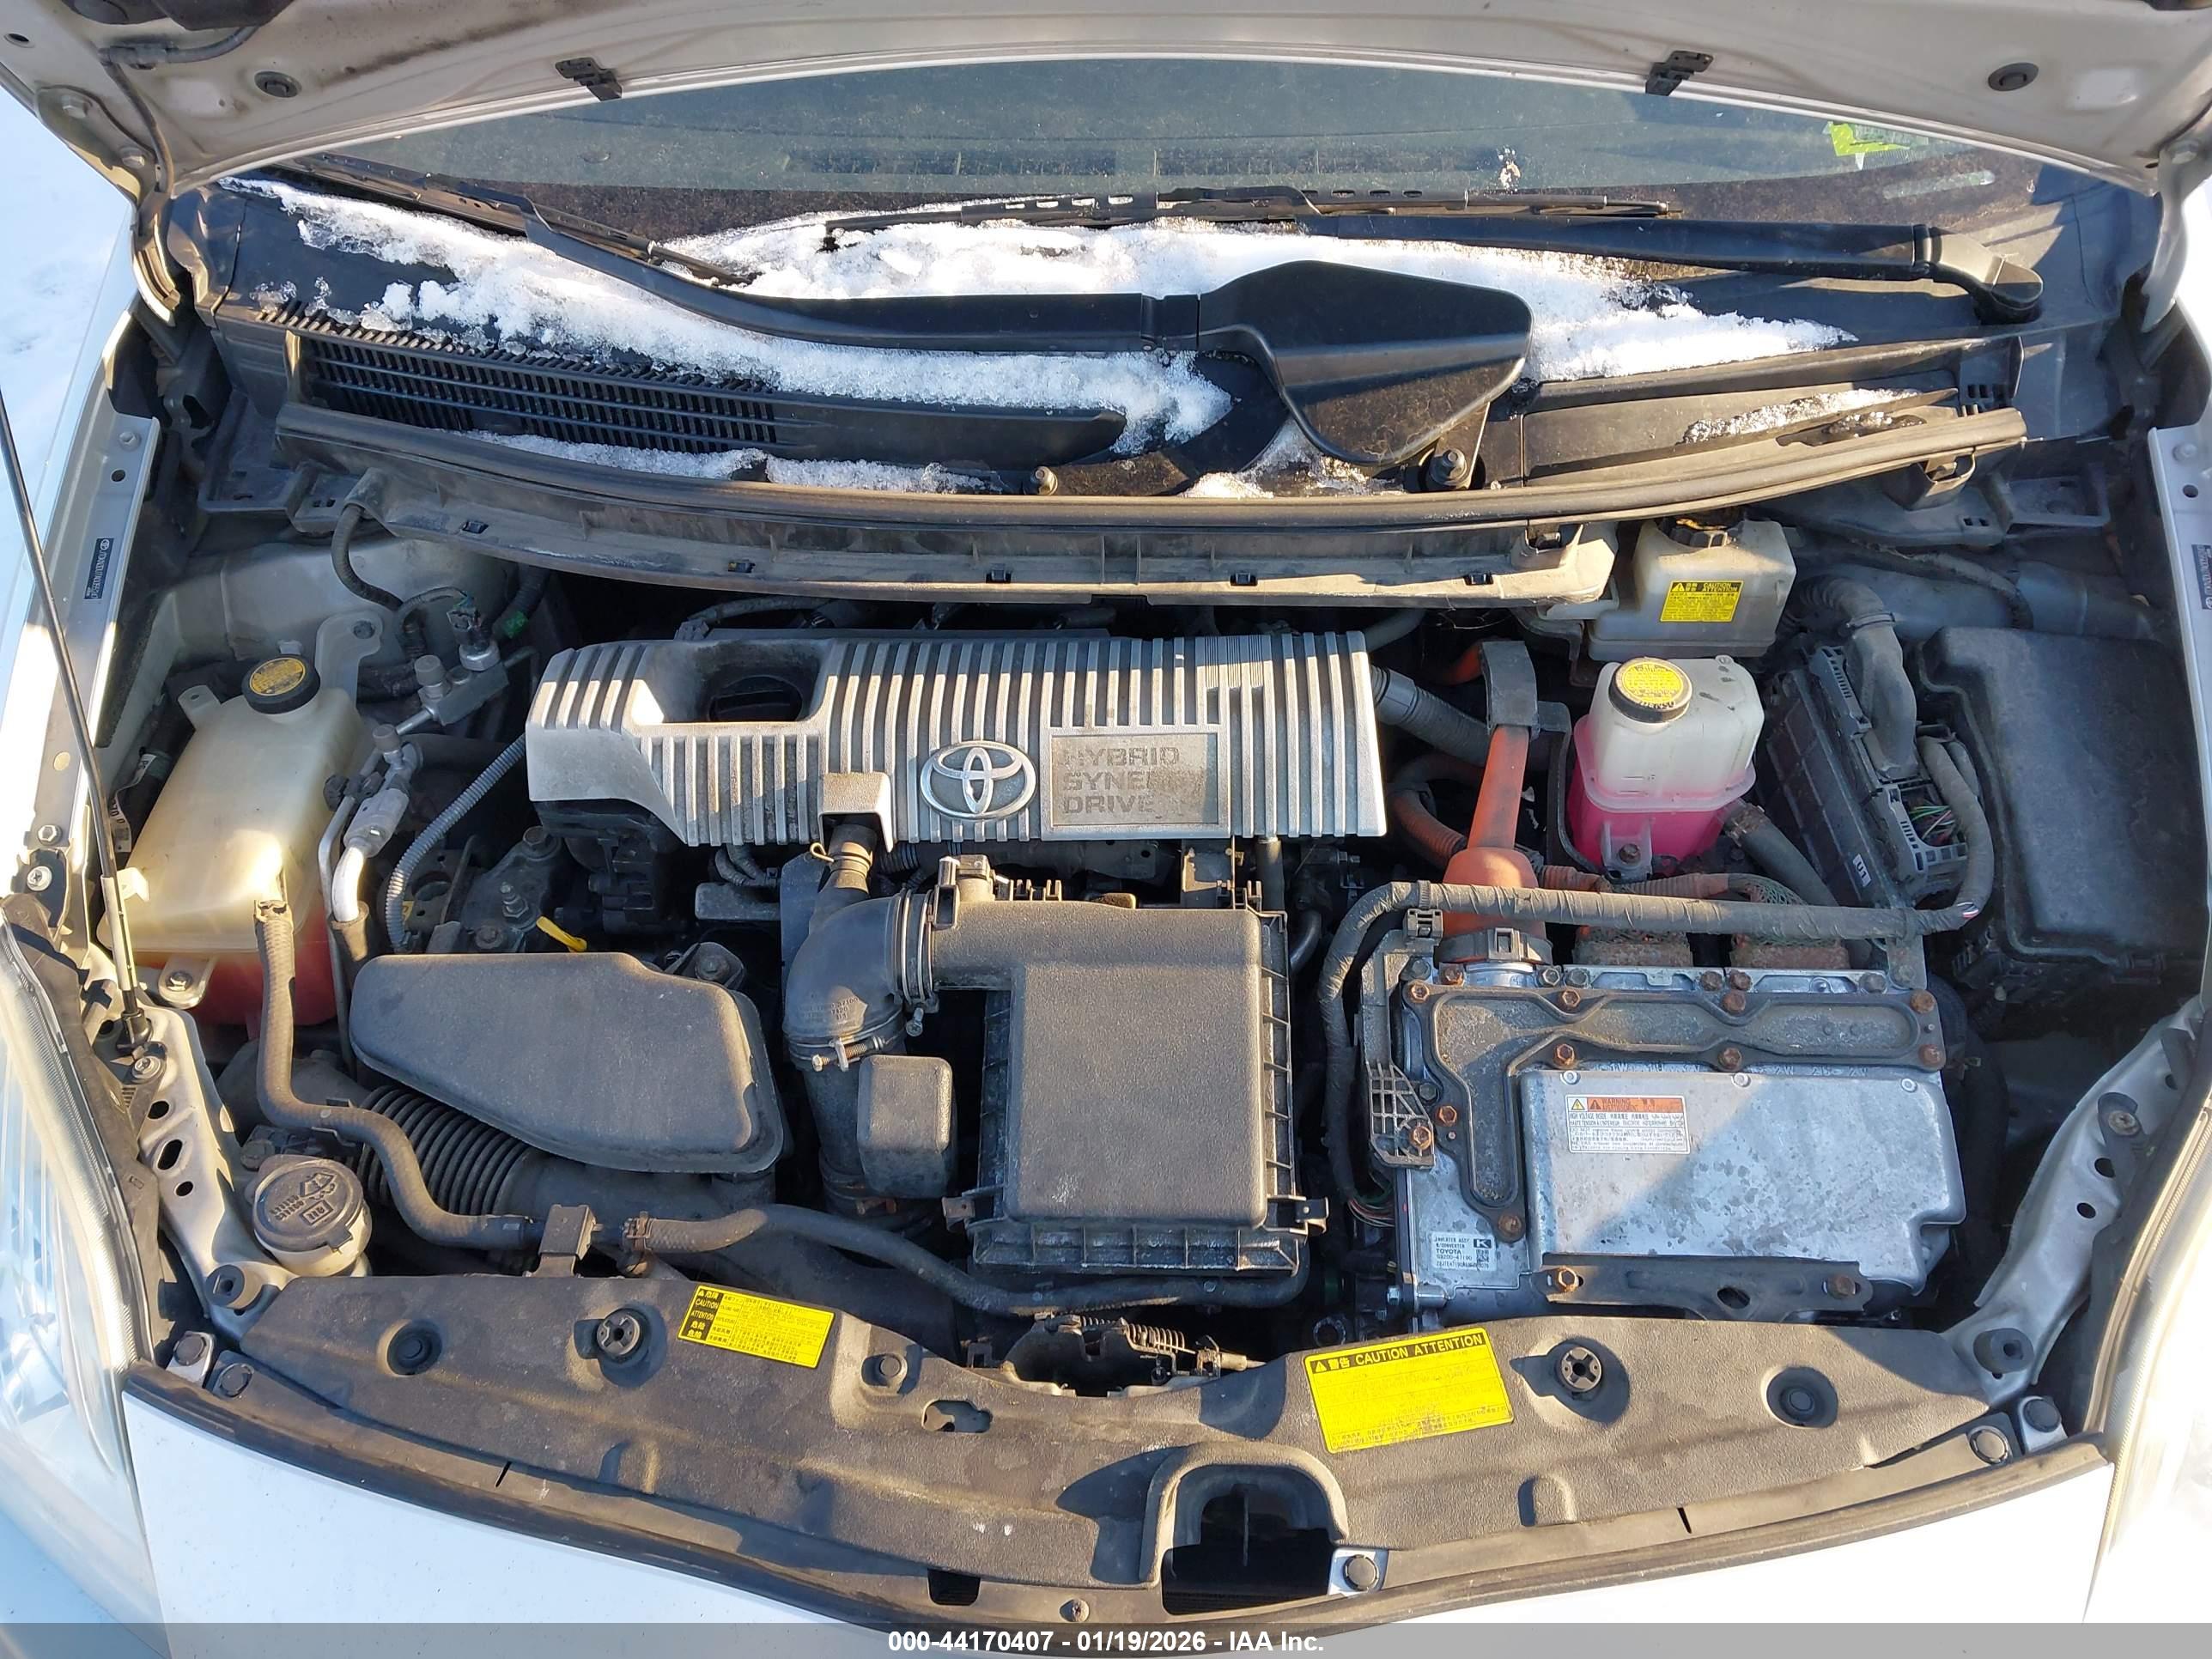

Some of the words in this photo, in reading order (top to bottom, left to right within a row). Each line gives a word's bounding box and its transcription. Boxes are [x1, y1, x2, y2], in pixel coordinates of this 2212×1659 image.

[1064, 795, 1155, 813] DRIVE
[695, 1297, 720, 1310] CAUTION
[690, 1309, 714, 1321] ATTENTION
[1355, 1346, 1409, 1365] CAUTION
[1414, 1334, 1483, 1356] ATTENTION
